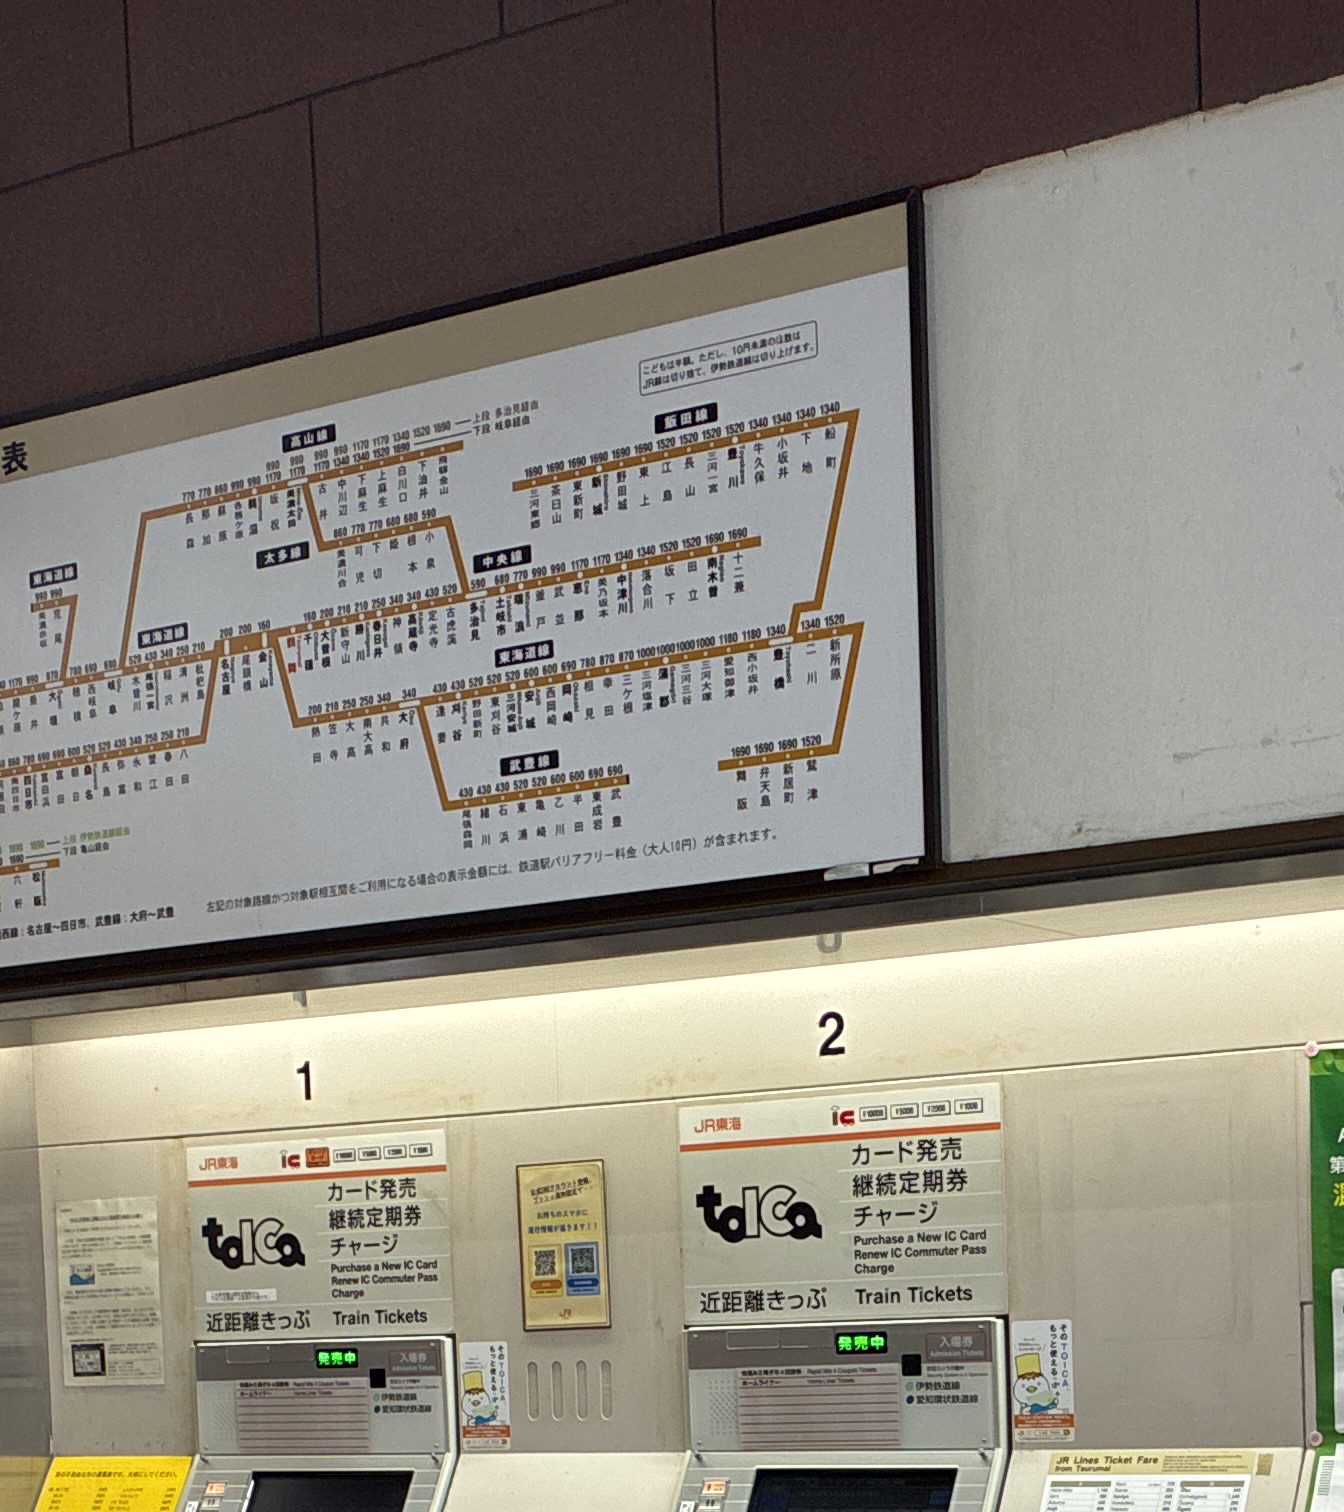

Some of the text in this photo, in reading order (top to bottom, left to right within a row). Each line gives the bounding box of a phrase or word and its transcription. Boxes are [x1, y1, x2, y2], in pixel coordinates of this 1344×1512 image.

[748, 417, 768, 431] 1340
[772, 412, 792, 426] 1340
[796, 406, 816, 421] 1340
[820, 401, 840, 415] 1340
[290, 429, 329, 449] 高山線
[483, 549, 522, 569] 中央線
[459, 764, 623, 798] 430 430 430 520 520 600 600 690 690
[818, 1011, 846, 1056] 2
[296, 1060, 312, 1100] 1
[694, 1117, 741, 1133] JR東海
[852, 1137, 962, 1167] カード発売
[199, 1156, 238, 1171] JR東海
[328, 1177, 417, 1202] カード発売
[852, 1168, 968, 1198] 継続定期券
[328, 1204, 422, 1231] 継続定期券
[854, 1201, 939, 1228] チャージ
[330, 1233, 399, 1256] チャージ
[854, 1230, 986, 1247] Purchase a New IC Card
[854, 1245, 986, 1260] Renew IC Commuter Pass
[331, 1260, 438, 1274] Purchase a New IC Card
[854, 1263, 894, 1275] Charge
[332, 1273, 438, 1286] Renew IC Commuter Pass
[332, 1289, 365, 1299] Charge
[700, 1287, 827, 1314] 近距離きっぷ
[856, 1286, 973, 1305] Train Tickets
[206, 1309, 311, 1333] 近距離きっぷ
[333, 1309, 428, 1326] Train Tickets
[838, 1335, 885, 1351] 発売中
[318, 1351, 357, 1366] 発売中
[1056, 1456, 1069, 1465] JR
[1074, 1456, 1099, 1465] Lines
[1105, 1456, 1132, 1464] Ticket
[1137, 1456, 1158, 1464] Fare
